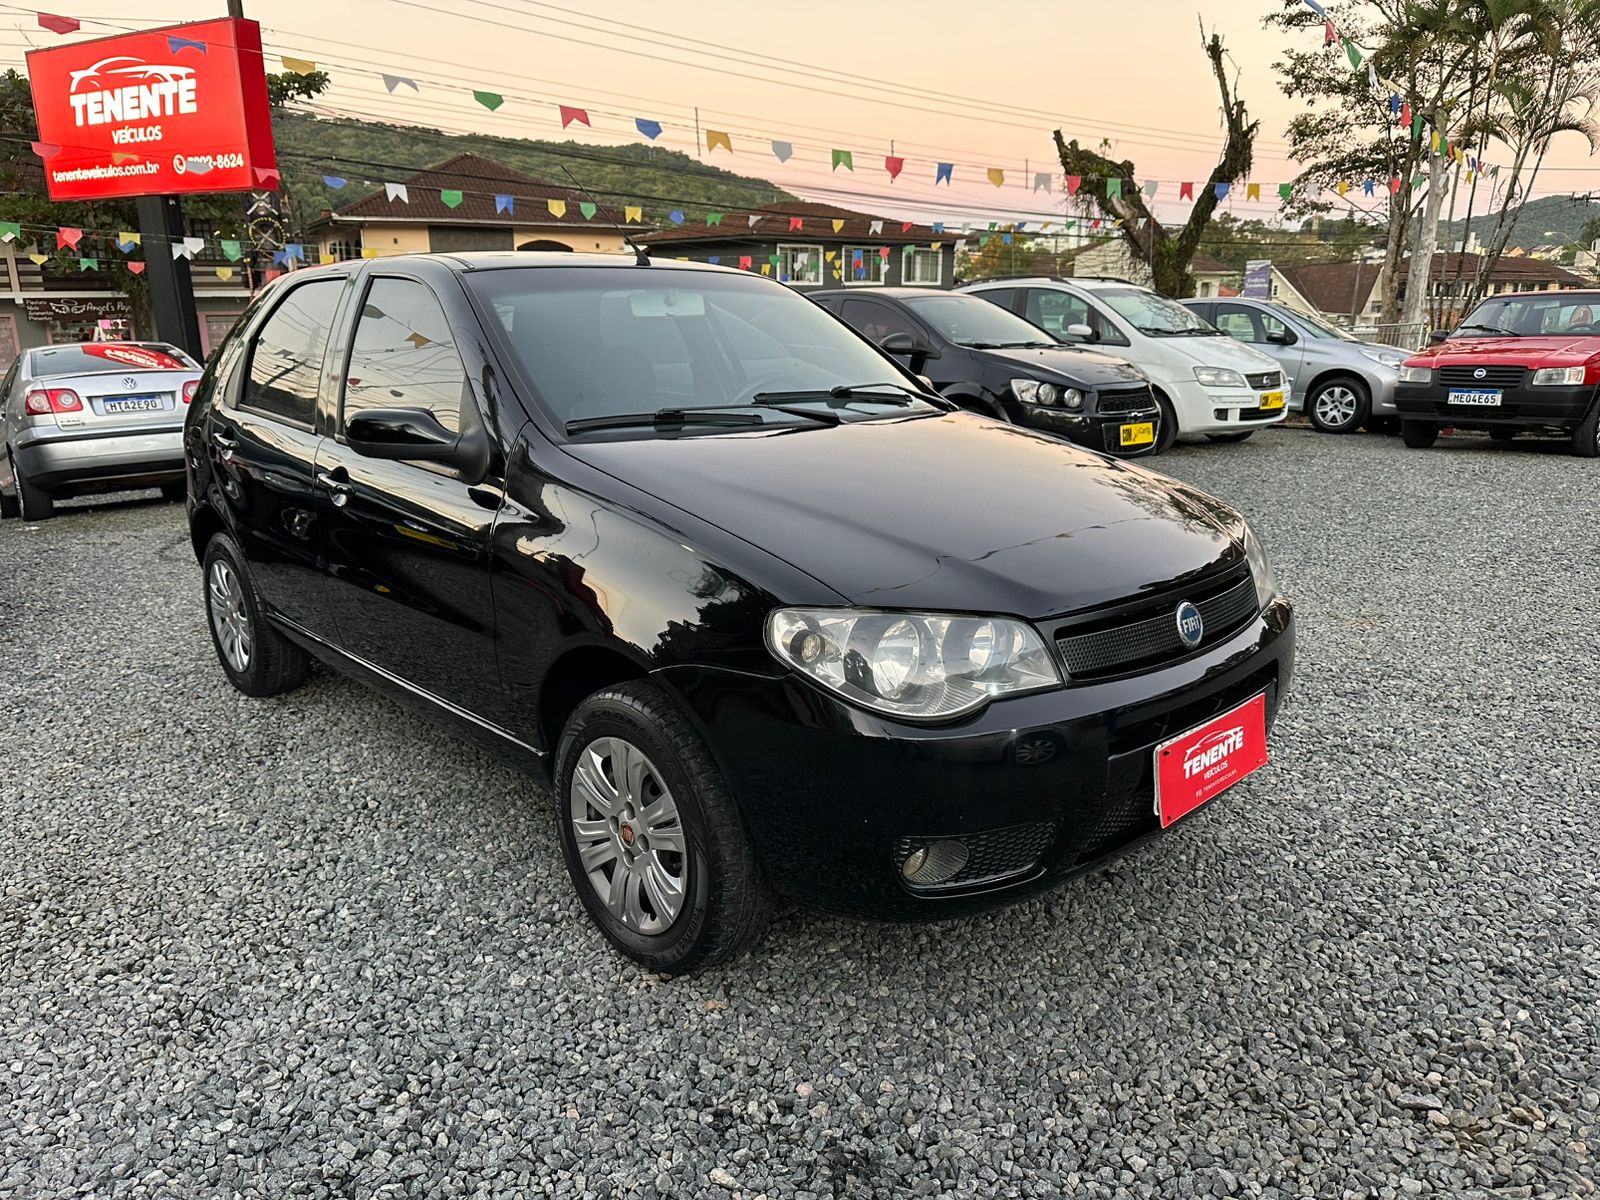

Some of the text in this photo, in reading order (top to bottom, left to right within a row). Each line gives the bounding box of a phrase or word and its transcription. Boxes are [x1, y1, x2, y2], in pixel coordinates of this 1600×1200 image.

[69, 78, 198, 127] TENENTE
[111, 125, 163, 145] VEÍCULOS
[52, 161, 160, 183] tenenteveiculos.com.br
[109, 399, 158, 413] HTA2E90
[1182, 614, 1200, 634] FIAT
[1183, 729, 1244, 780] TENENTE
